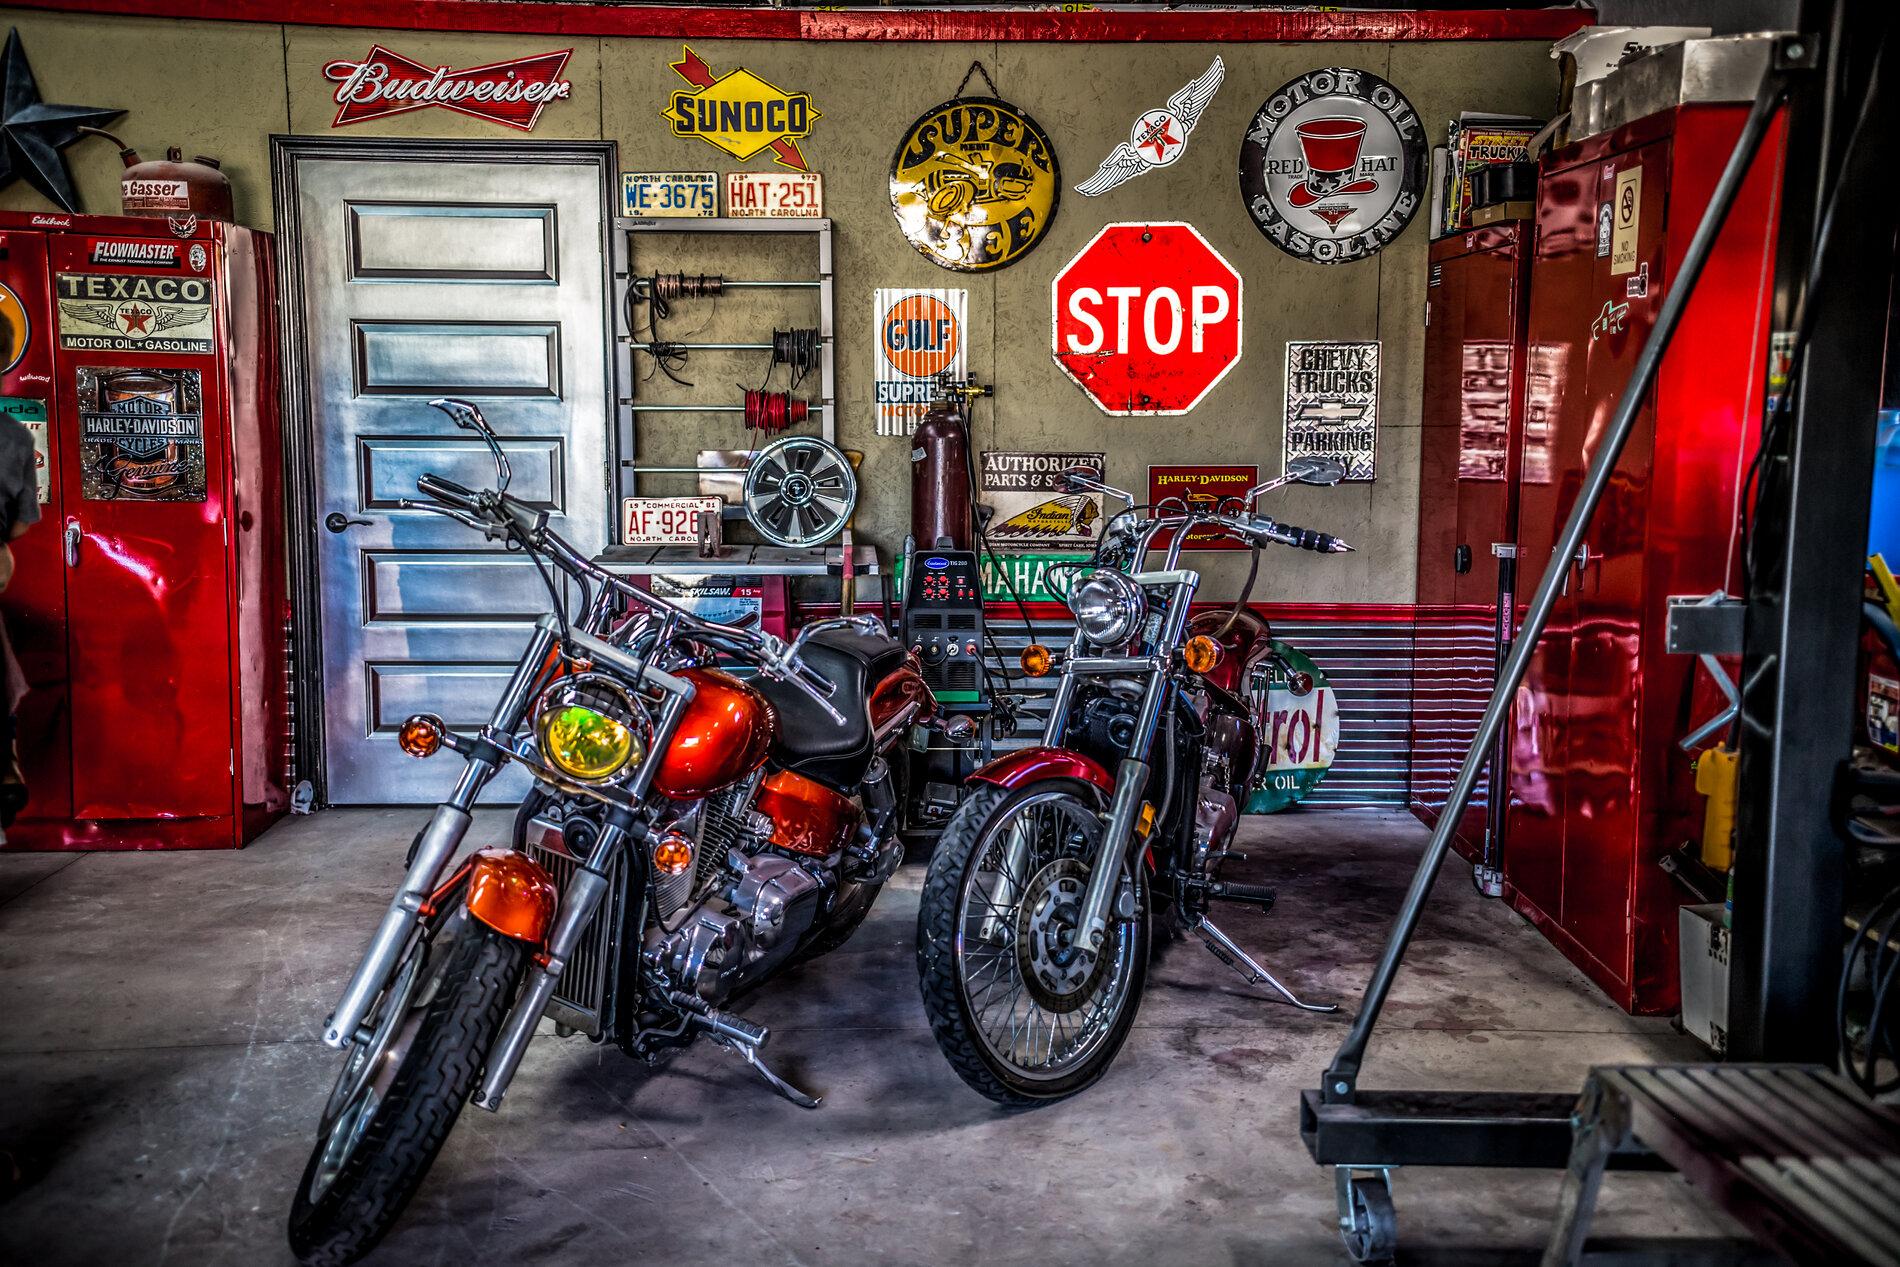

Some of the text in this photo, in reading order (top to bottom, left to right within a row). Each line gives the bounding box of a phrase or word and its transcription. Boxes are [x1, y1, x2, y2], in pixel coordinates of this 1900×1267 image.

[325, 63, 570, 104] Budweiser
[675, 96, 807, 133] SUNOCO
[1248, 71, 1418, 149] MOTOR OIL
[1136, 115, 1166, 142] TEXACO
[902, 106, 1050, 173] SUPER
[1268, 157, 1398, 175] RED HAT
[130, 181, 181, 196] Gasser
[626, 175, 661, 183] NORTH
[31, 215, 71, 227] Edelbrock
[731, 208, 766, 217] NORTH
[1252, 191, 1417, 261] GASOLINE
[93, 241, 175, 262] FLOWMASTER
[62, 275, 205, 301] TEXACO
[1066, 285, 1230, 355] STOP
[67, 337, 208, 352] MOTOR OIL GASOLINE
[886, 319, 951, 352] GULF
[1300, 348, 1367, 371] CHEVY
[877, 382, 964, 402] SUPRE
[1294, 371, 1373, 394] TRUCKS
[86, 417, 195, 435] HARLEY-DAVIDSON
[1291, 432, 1373, 452] PARKING
[984, 473, 1027, 487] PARTS
[1030, 474, 1042, 487] &
[1026, 507, 1070, 521] Indian
[740, 588, 752, 596] 15
[1275, 776, 1300, 790] OIL
